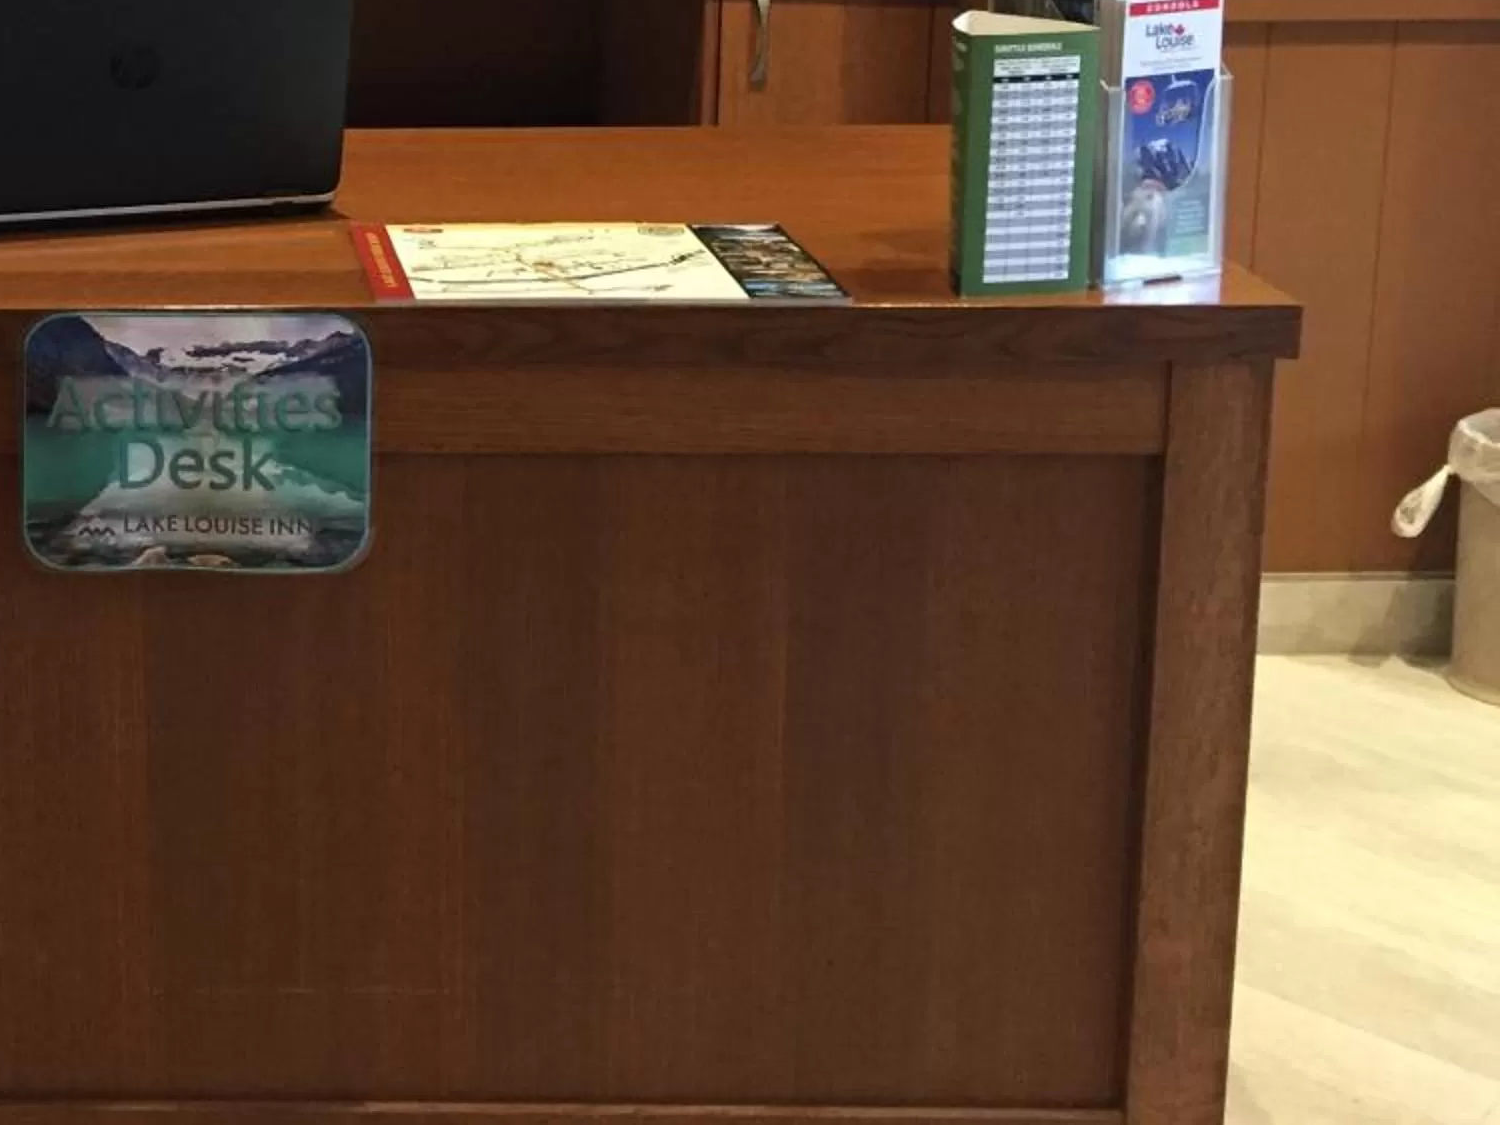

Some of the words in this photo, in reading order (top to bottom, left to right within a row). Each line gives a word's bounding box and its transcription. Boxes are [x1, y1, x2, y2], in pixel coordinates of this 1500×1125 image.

[1145, 22, 1174, 37] Lake
[1156, 35, 1195, 49] Louise
[50, 375, 344, 433] Activities
[119, 433, 277, 491] Desk
[123, 514, 178, 533] LAKE
[185, 515, 263, 536] LOUISE
[269, 518, 313, 536] INN
